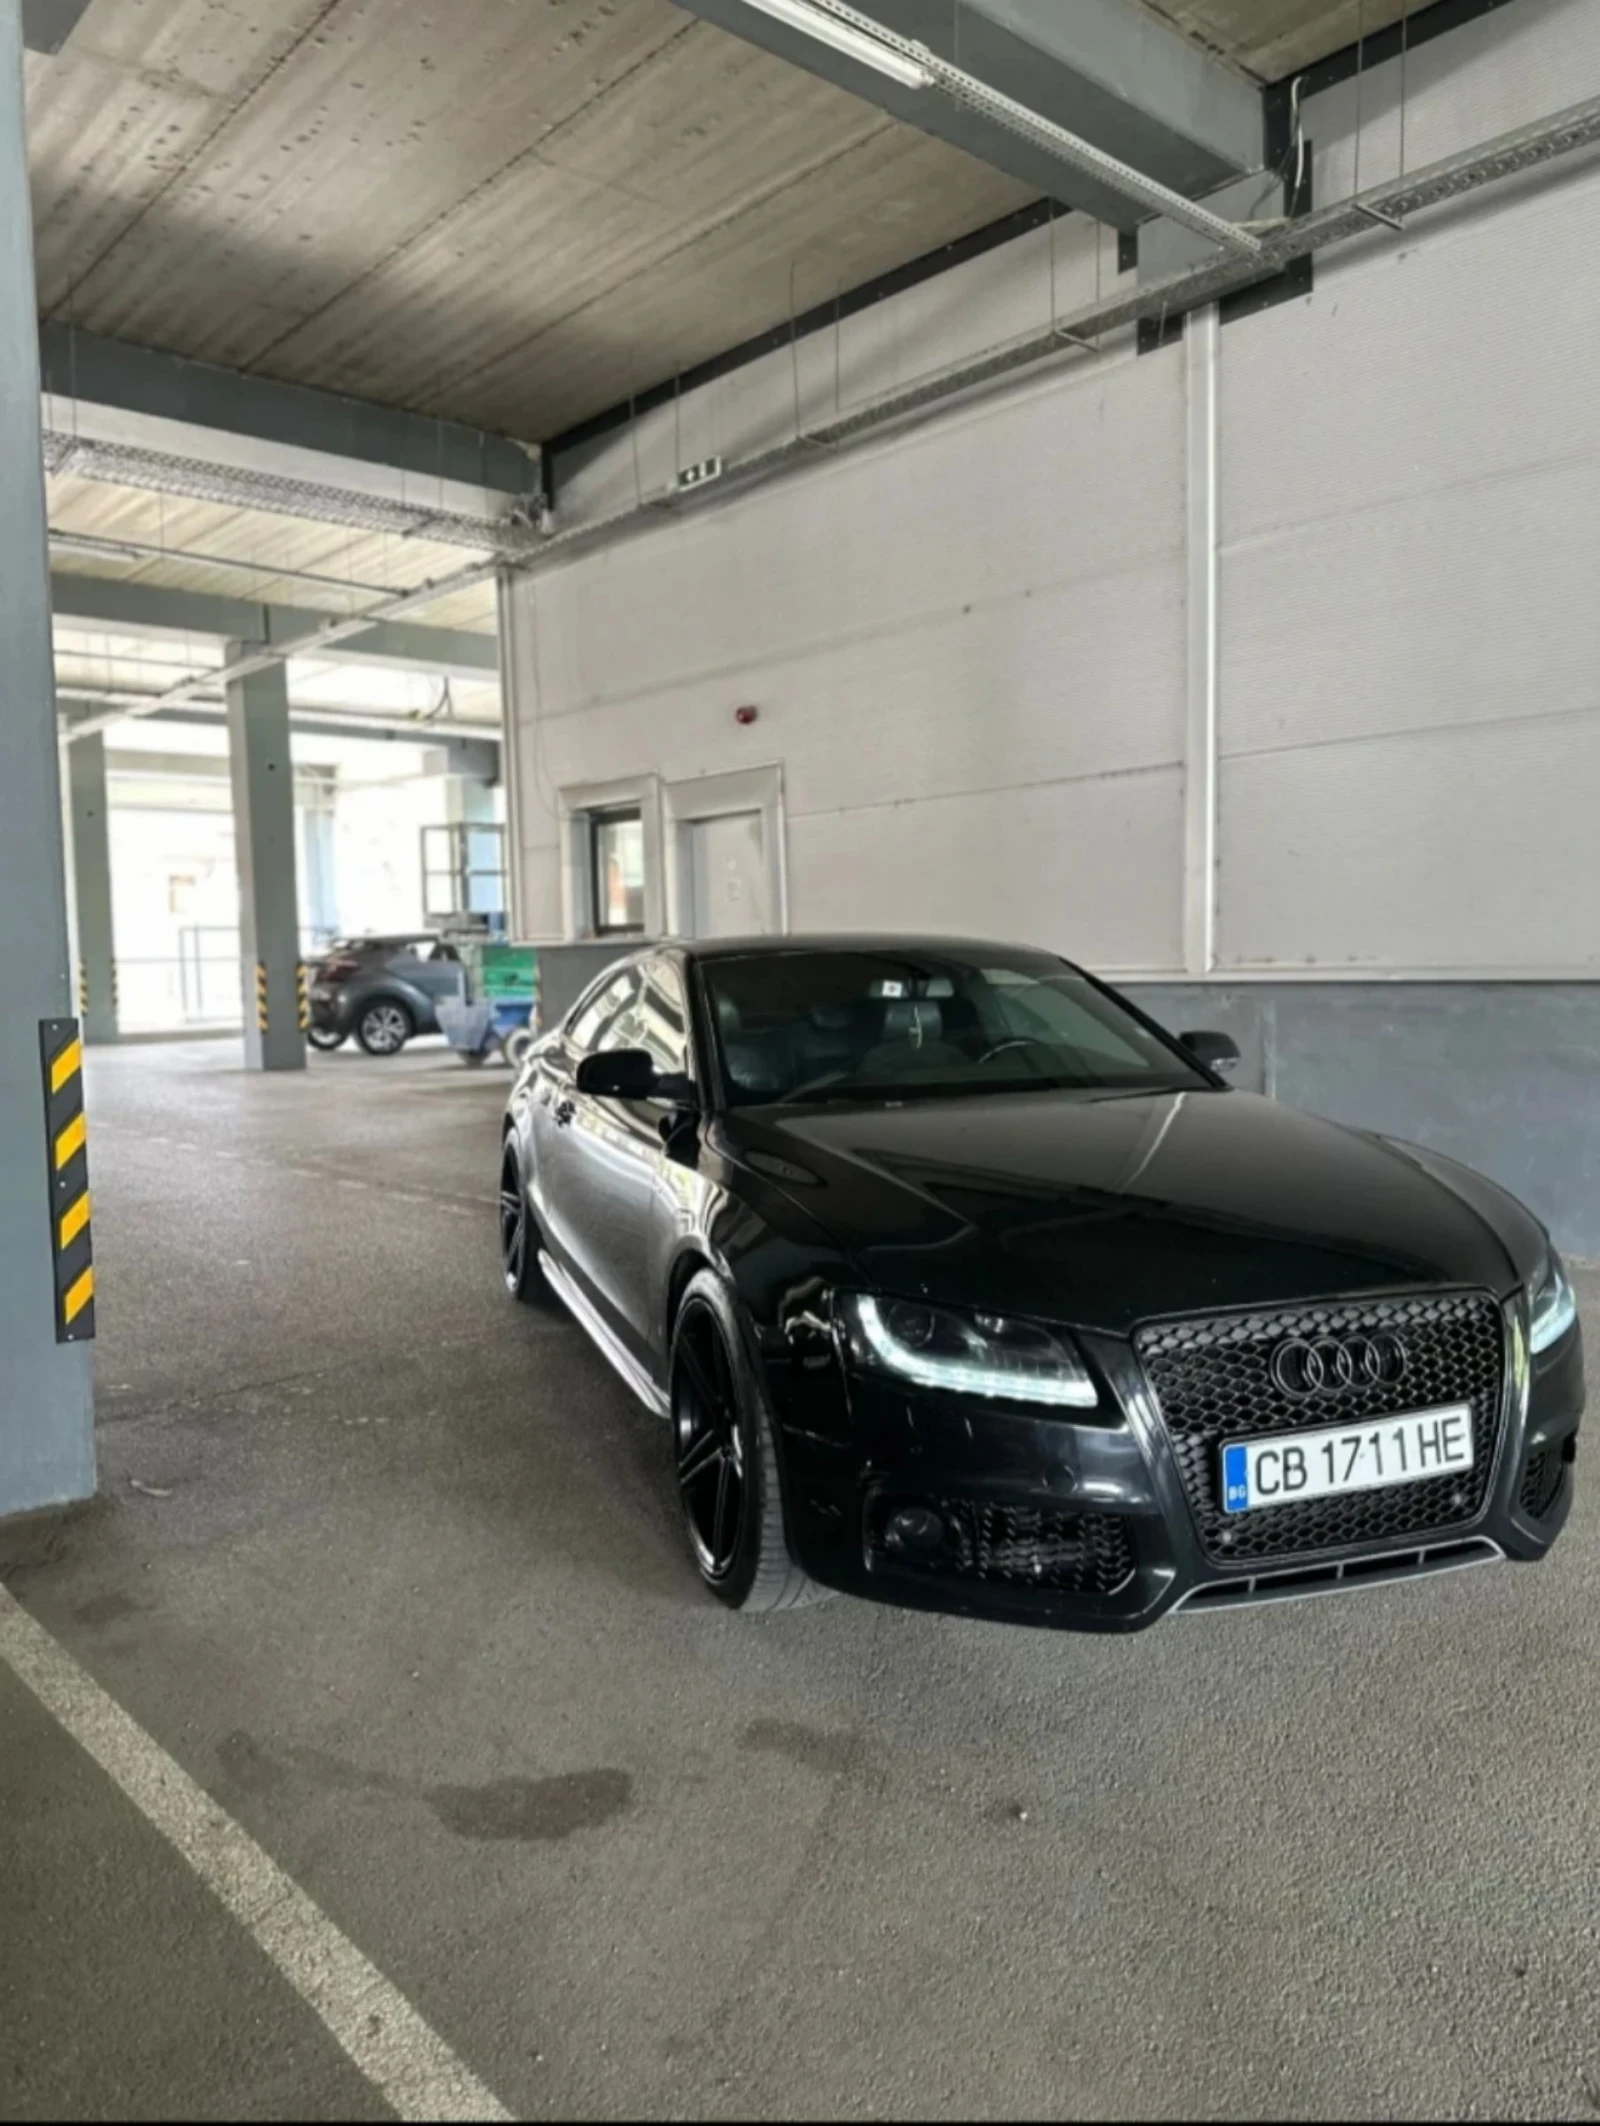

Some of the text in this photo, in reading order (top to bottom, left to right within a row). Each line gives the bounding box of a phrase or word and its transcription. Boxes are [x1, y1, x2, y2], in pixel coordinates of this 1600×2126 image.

[1255, 1416, 1466, 1496] CB 1711 HE
[1228, 1485, 1247, 1500] BG
